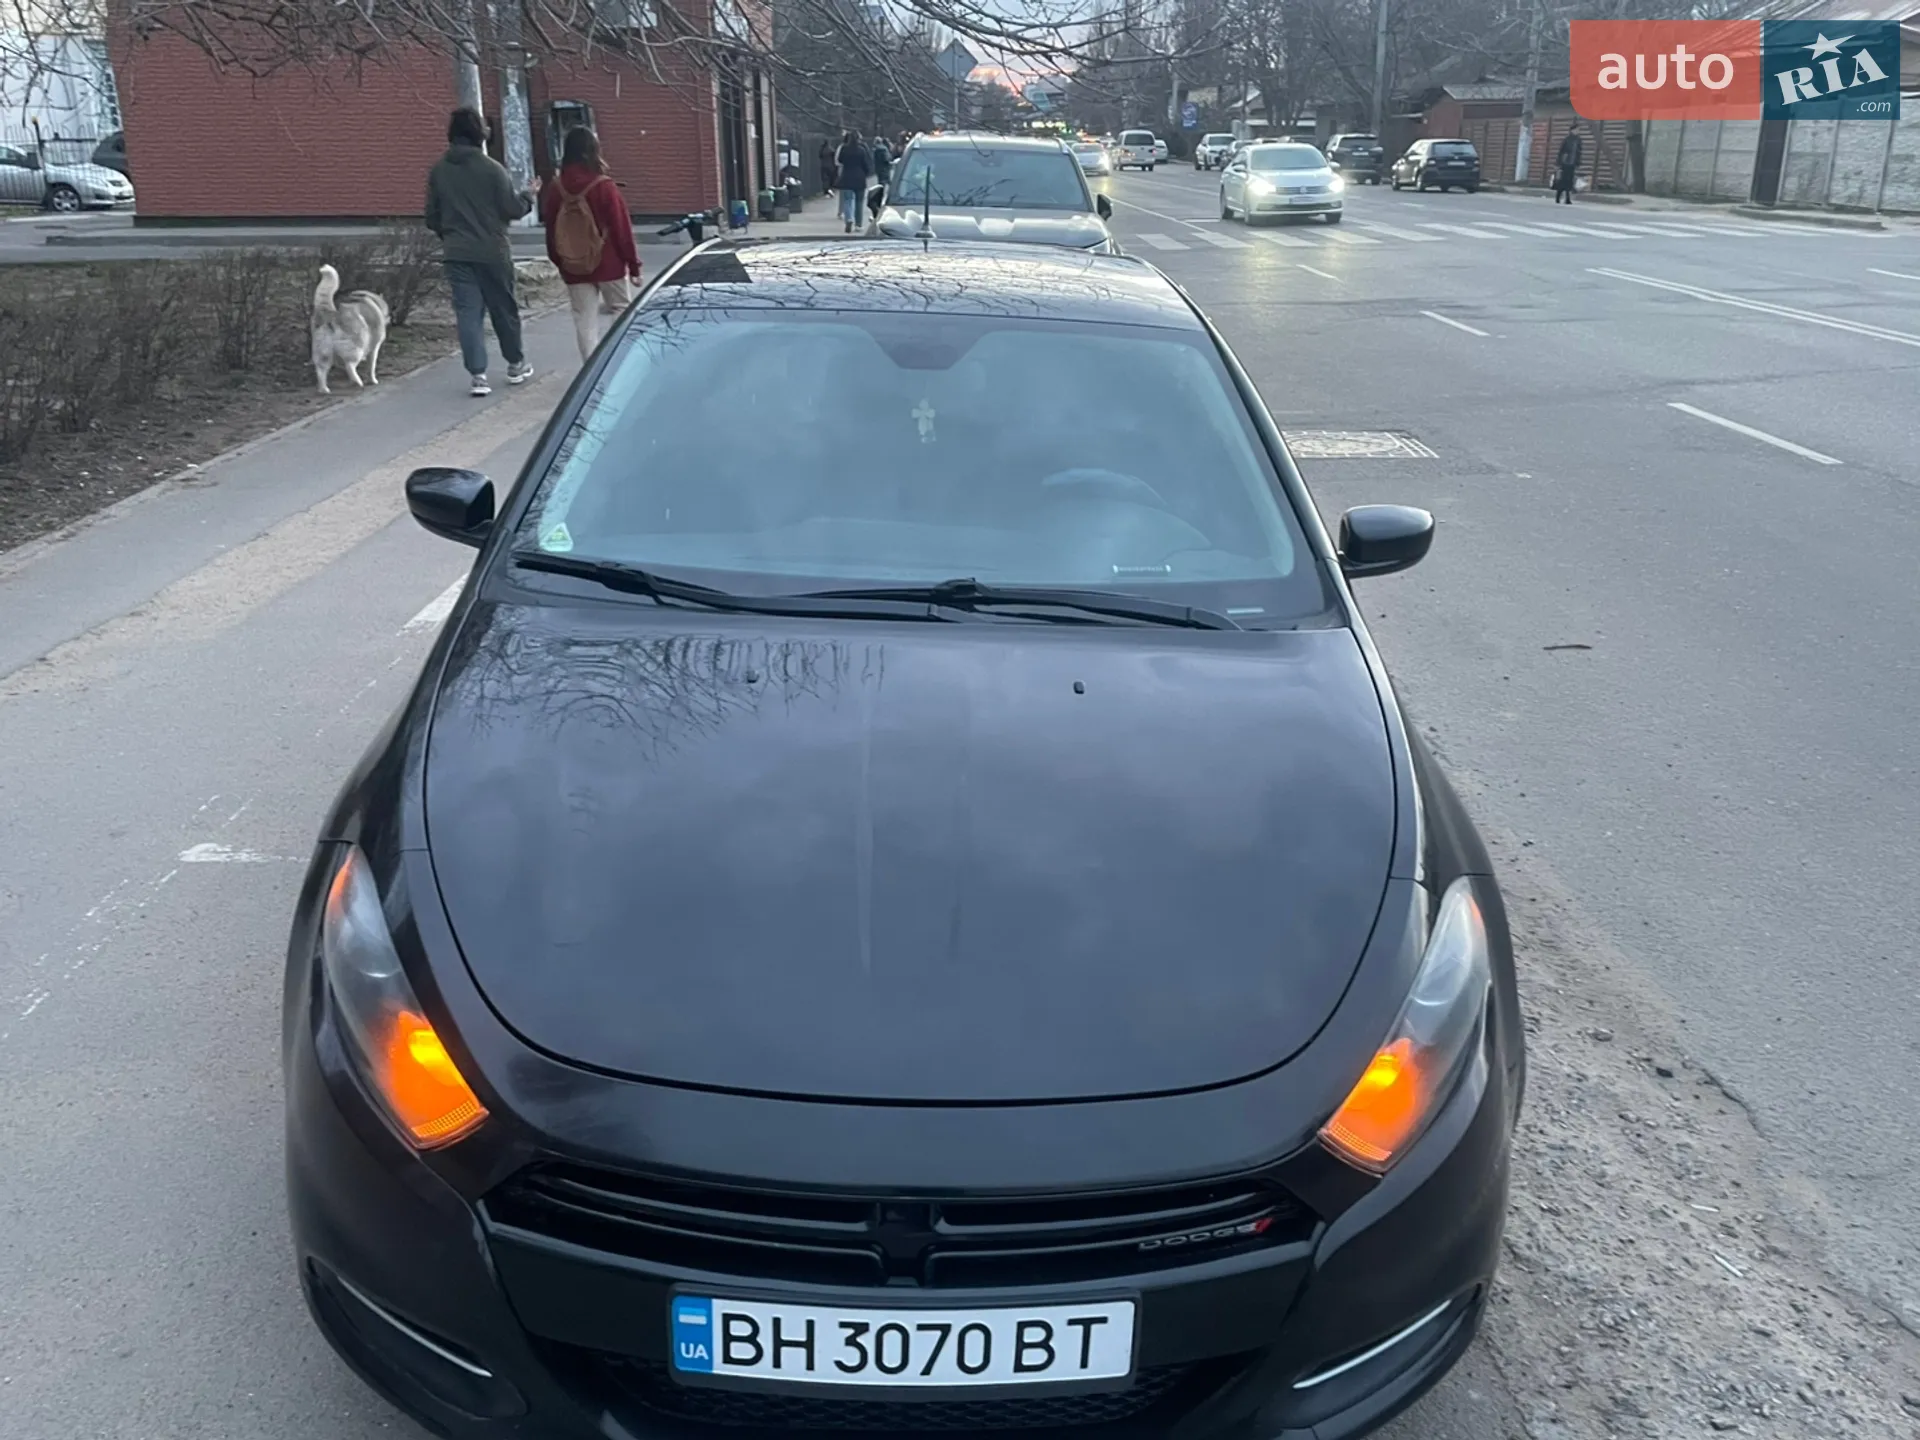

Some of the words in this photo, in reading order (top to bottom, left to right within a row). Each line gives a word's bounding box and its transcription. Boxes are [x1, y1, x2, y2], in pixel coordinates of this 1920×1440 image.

[680, 1341, 709, 1360] UA
[721, 1312, 815, 1371] BH
[833, 1320, 993, 1376] 3070
[1012, 1316, 1109, 1373] BT
